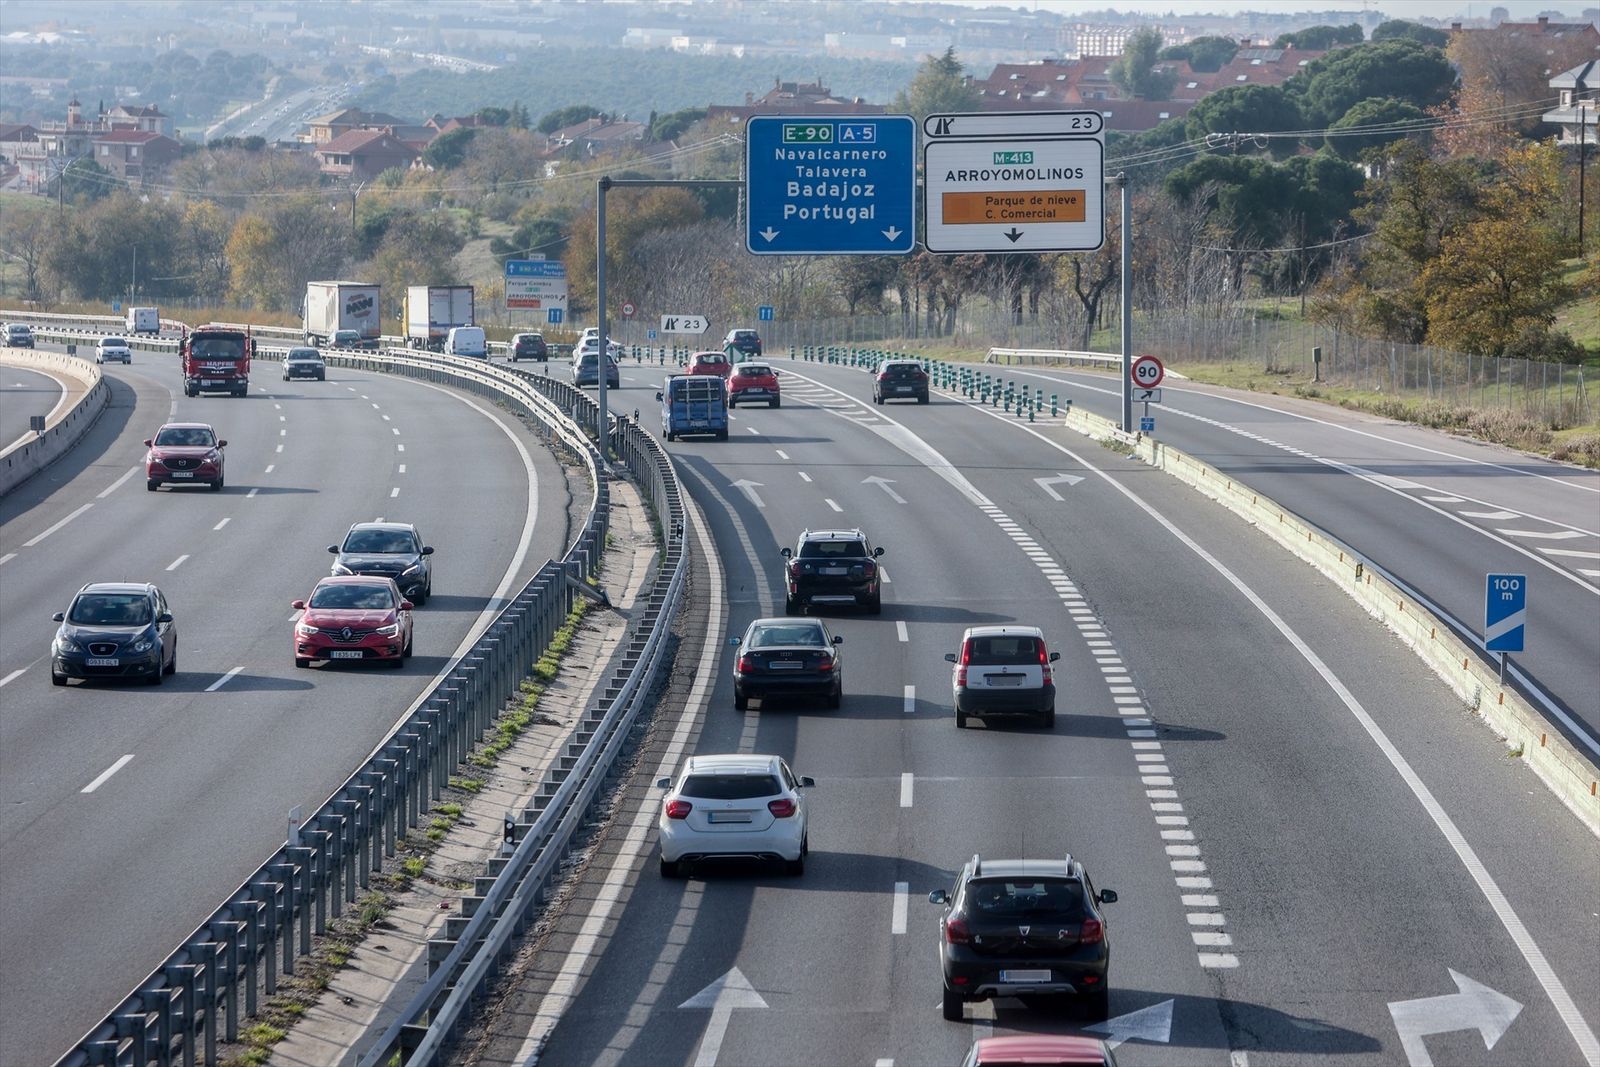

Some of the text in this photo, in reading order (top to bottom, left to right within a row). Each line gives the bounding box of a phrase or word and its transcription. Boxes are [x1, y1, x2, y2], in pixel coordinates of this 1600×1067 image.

[1071, 117, 1092, 129] 23
[786, 127, 873, 140] E-90 A-5
[775, 148, 887, 160] Navalcarnero
[994, 152, 1032, 164] M-413
[796, 165, 867, 178] Talavera
[945, 168, 1084, 181] ARROYOMOLINOS
[787, 181, 875, 201] Badajoz
[985, 195, 1077, 208] Parque de nieve
[783, 204, 875, 224] Portugal
[985, 208, 1056, 219] C. Comercial
[684, 320, 700, 329] 23
[1138, 366, 1157, 378] 90
[1494, 578, 1520, 591] 100
[1501, 591, 1513, 600] m
